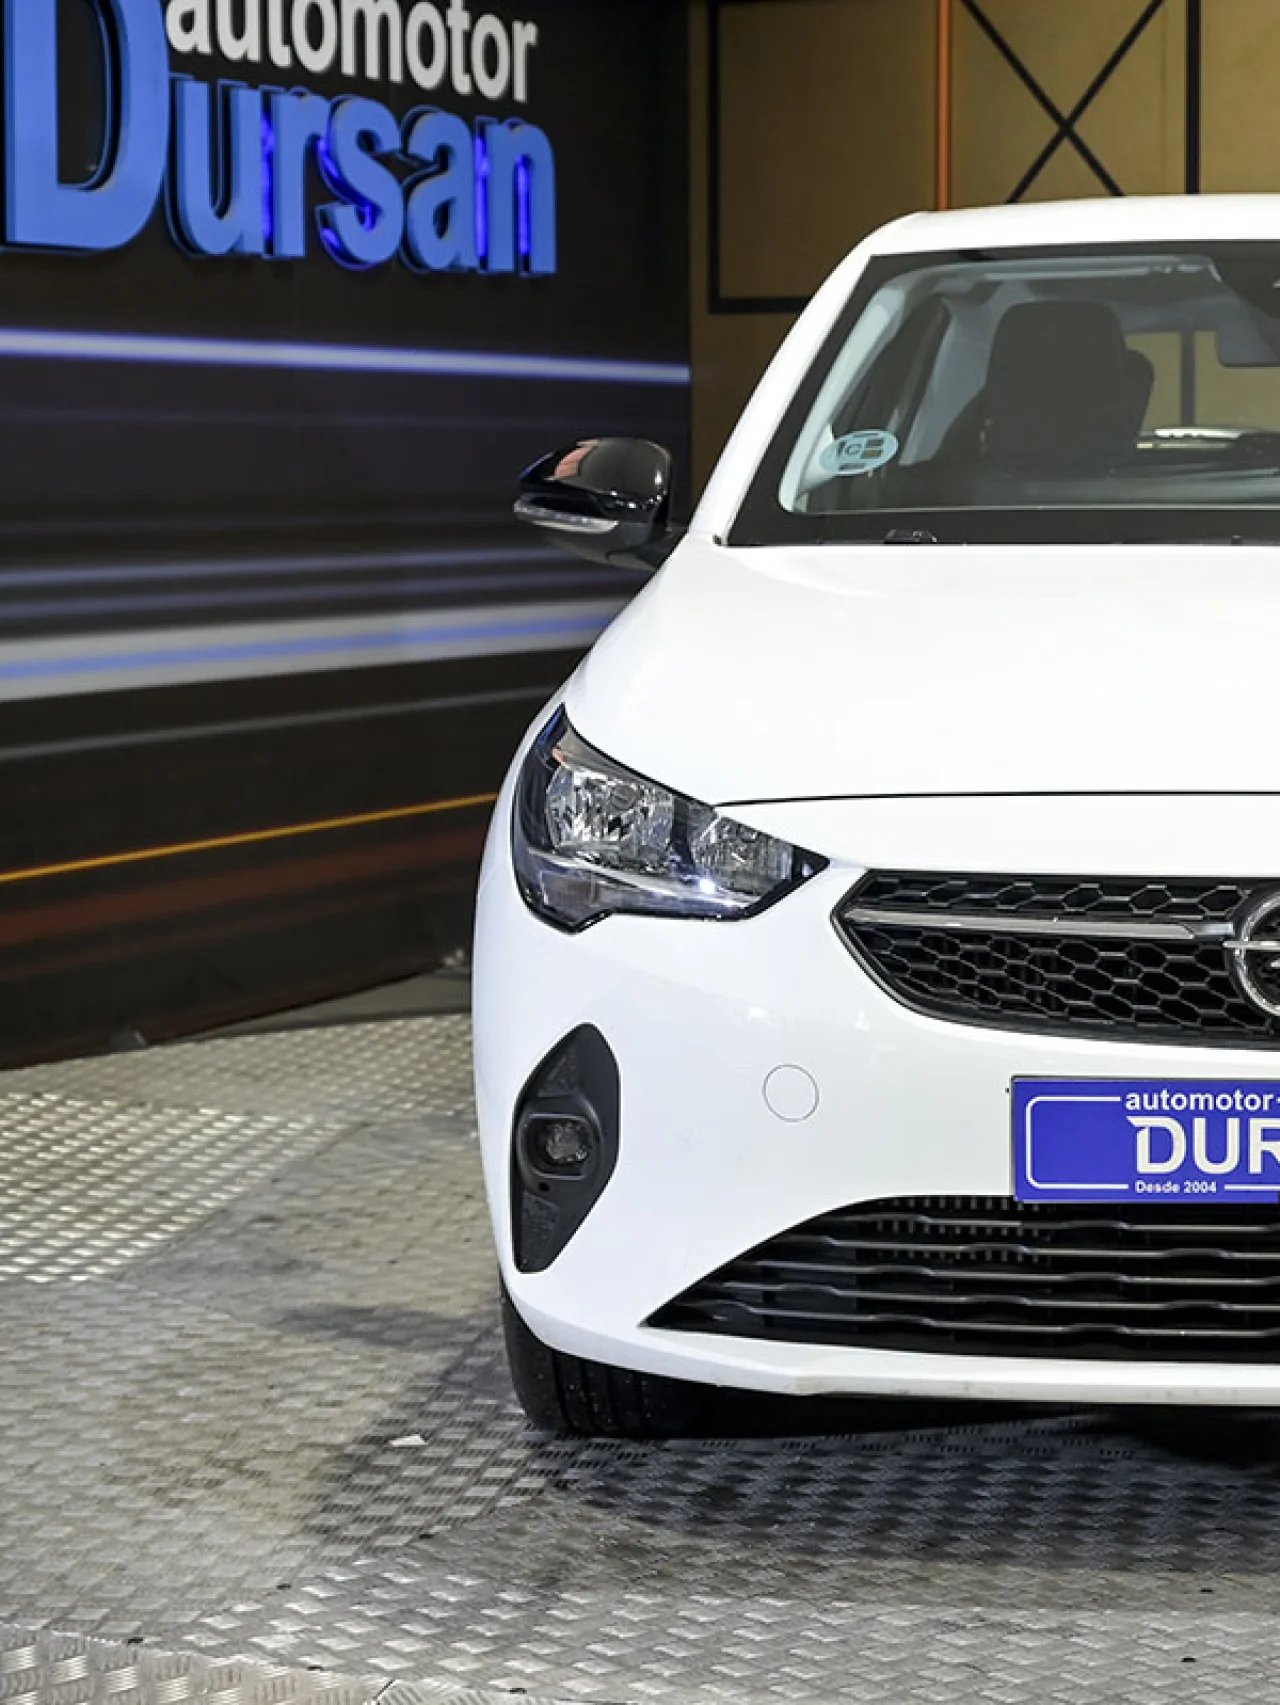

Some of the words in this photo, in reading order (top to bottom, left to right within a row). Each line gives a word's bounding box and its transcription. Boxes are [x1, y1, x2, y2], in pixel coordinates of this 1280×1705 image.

[166, 0, 538, 102] automotor
[4, 0, 556, 277] Dursan
[1125, 1089, 1274, 1112] automotor
[1135, 1180, 1180, 1194] Desde
[1183, 1180, 1217, 1194] 2004
